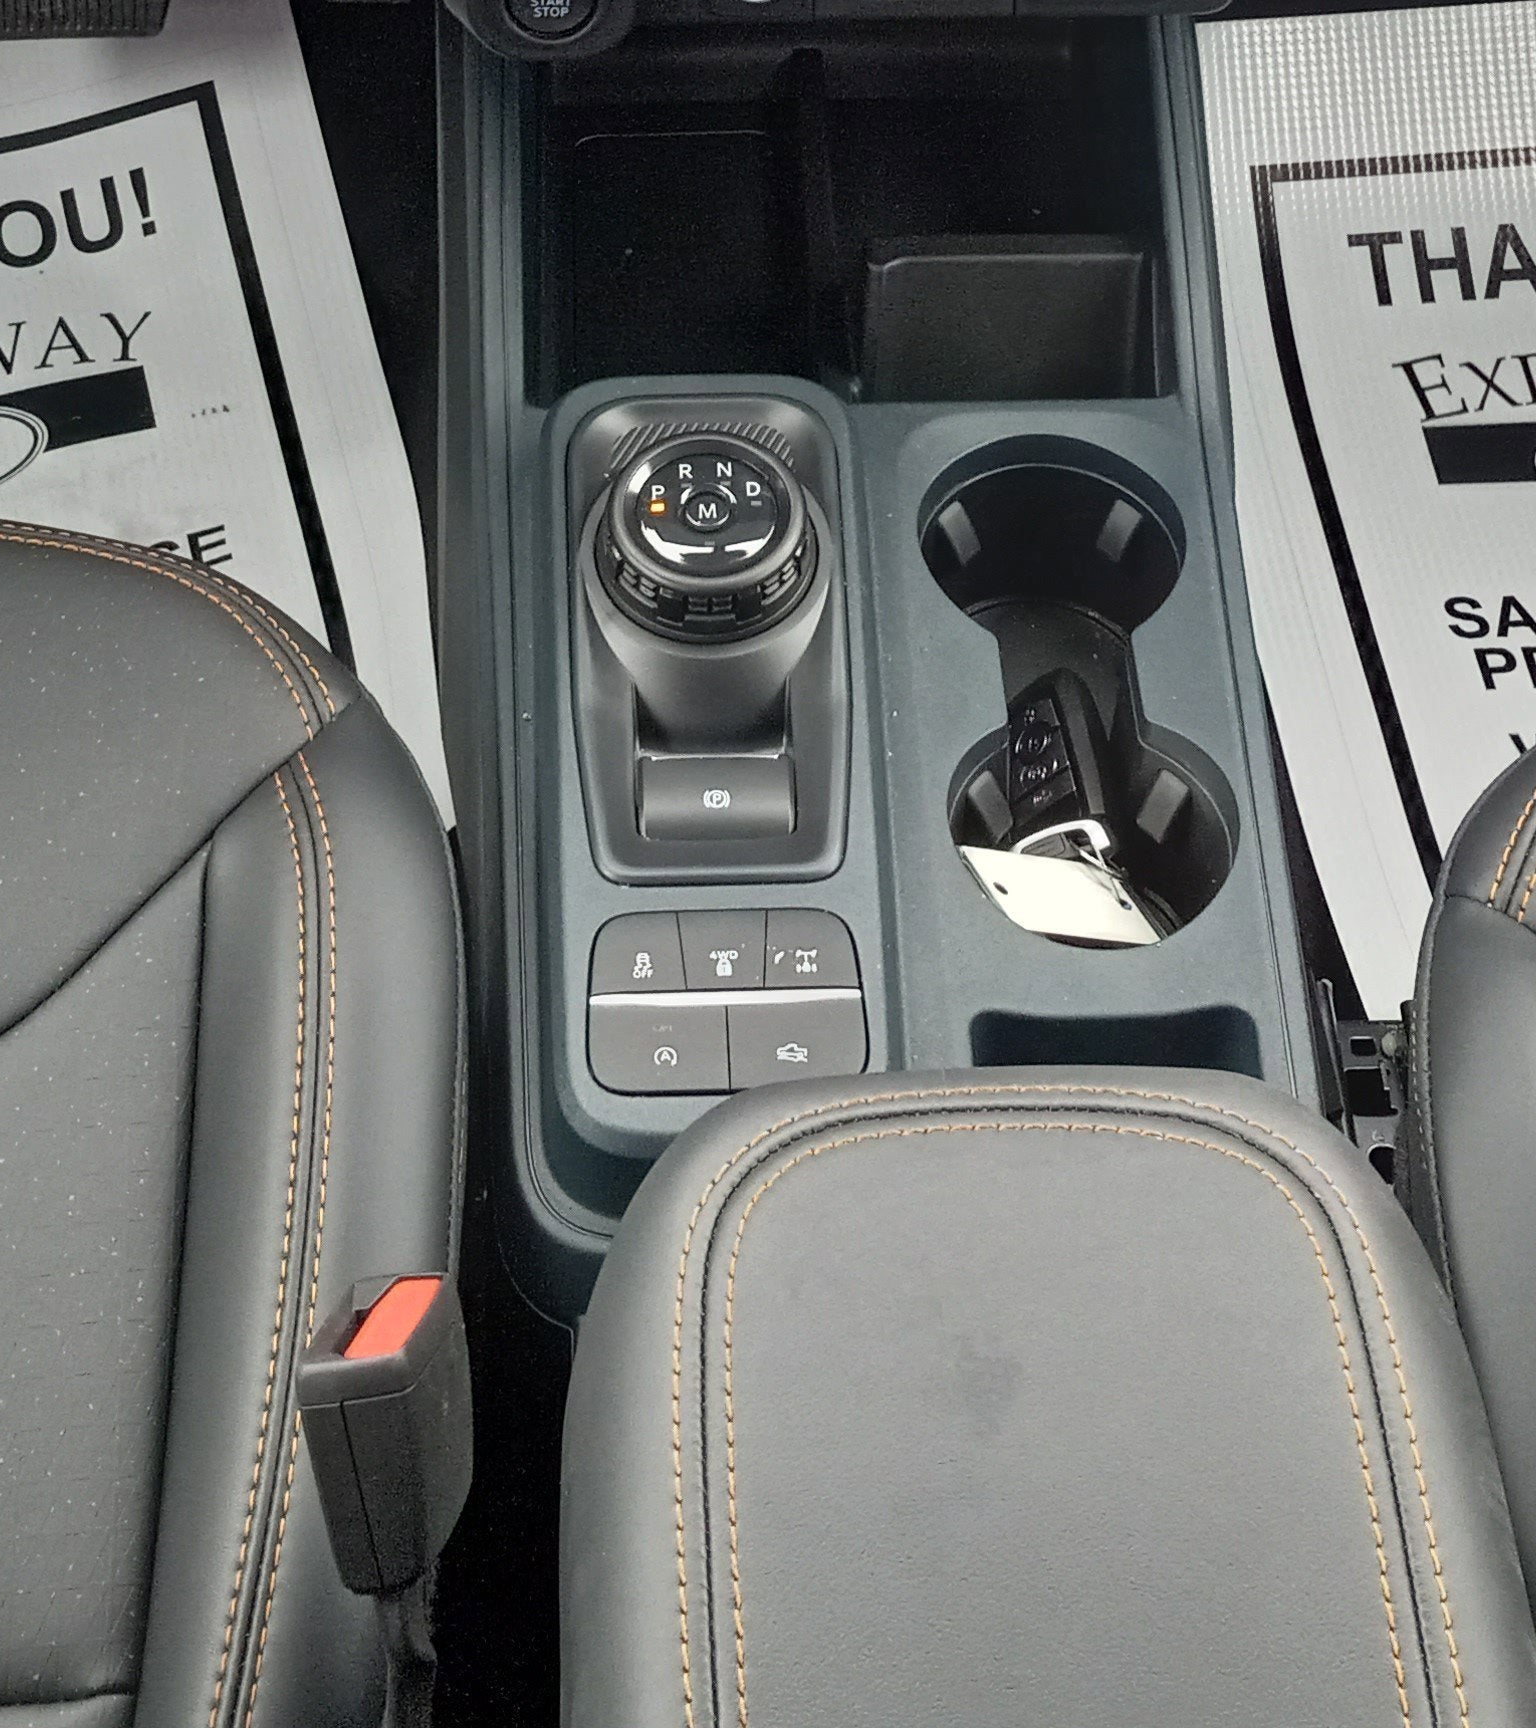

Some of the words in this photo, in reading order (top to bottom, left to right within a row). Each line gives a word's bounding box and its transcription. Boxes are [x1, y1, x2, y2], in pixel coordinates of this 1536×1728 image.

[532, 7, 569, 18] STOP
[678, 463, 693, 480] R
[716, 461, 732, 478] N
[650, 485, 666, 501] P
[745, 481, 761, 497] D
[698, 503, 717, 520] M
[709, 950, 739, 960] 4WD
[632, 969, 653, 979] OFF
